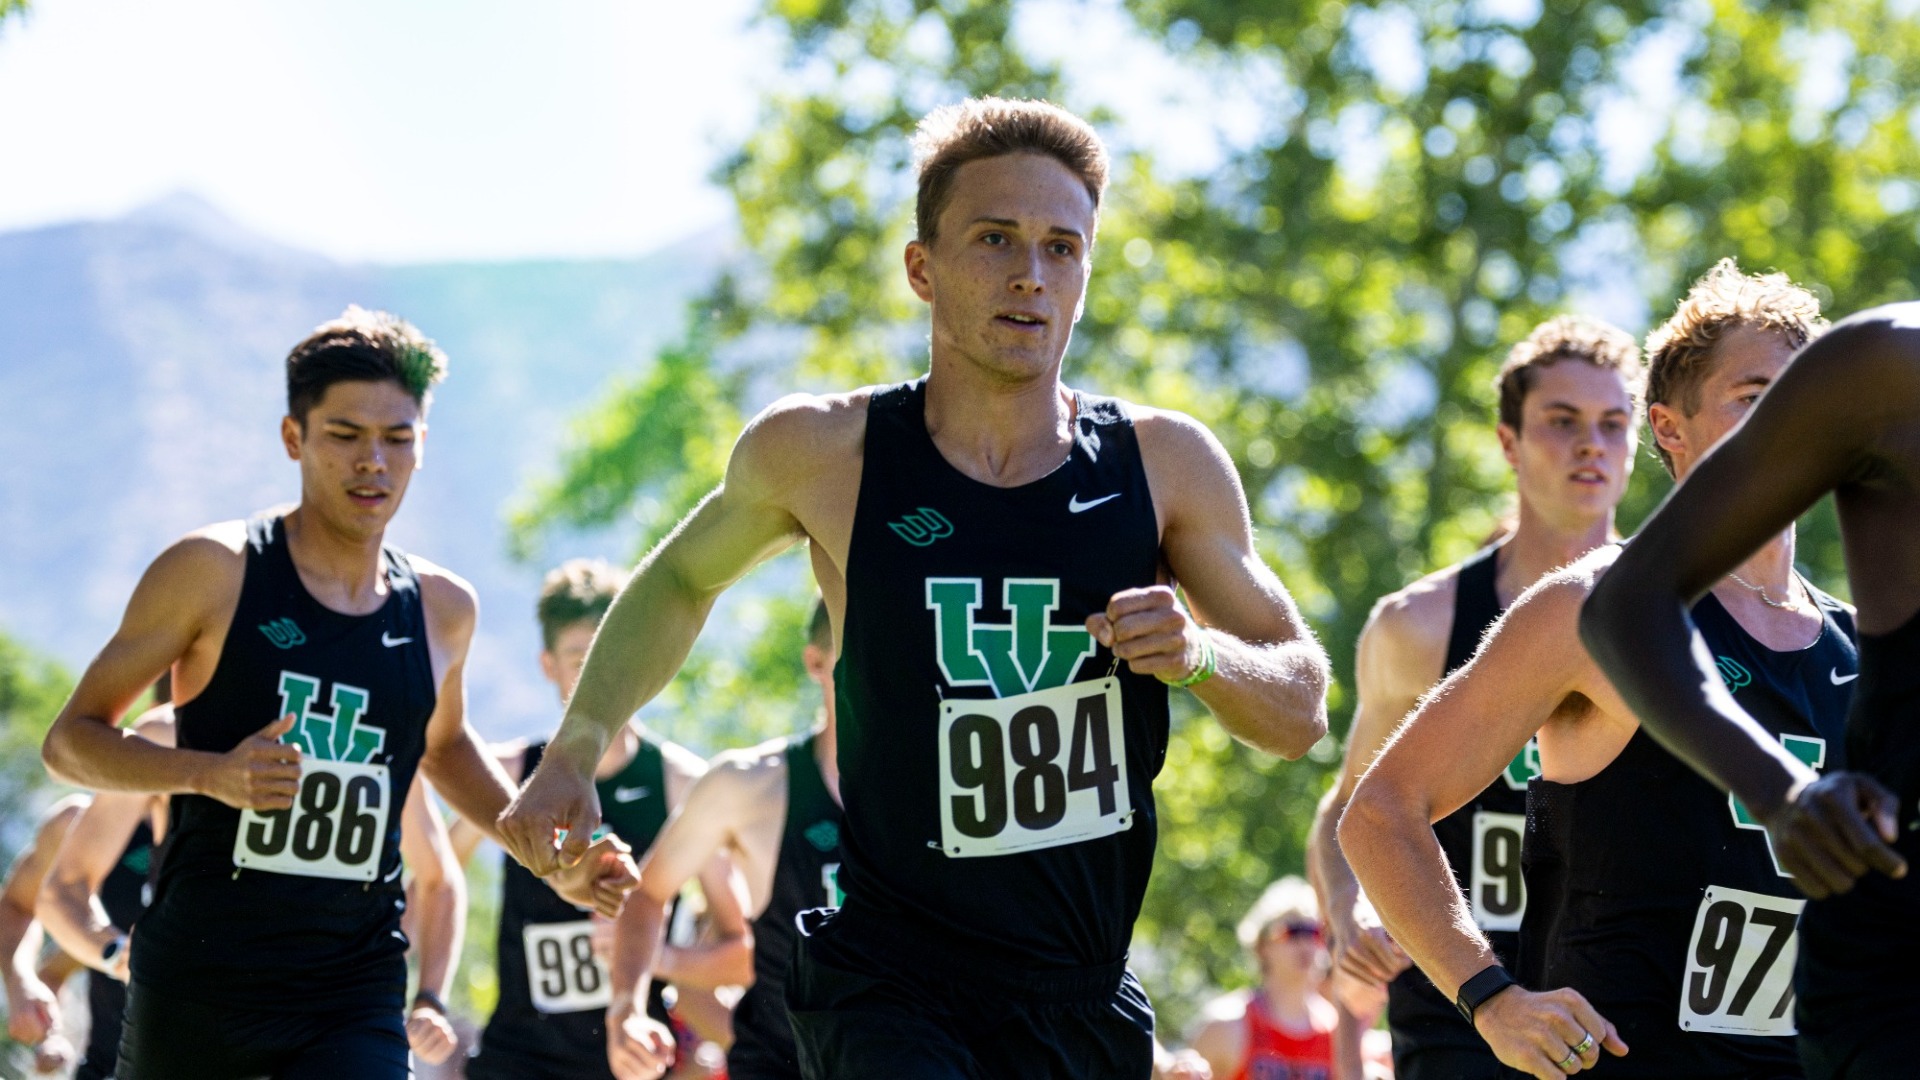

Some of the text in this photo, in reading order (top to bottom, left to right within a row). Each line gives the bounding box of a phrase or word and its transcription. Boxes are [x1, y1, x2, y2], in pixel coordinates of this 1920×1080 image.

[949, 692, 1120, 839] 984
[246, 771, 381, 865] 986
[1482, 826, 1523, 916] 9
[537, 935, 601, 997] 98
